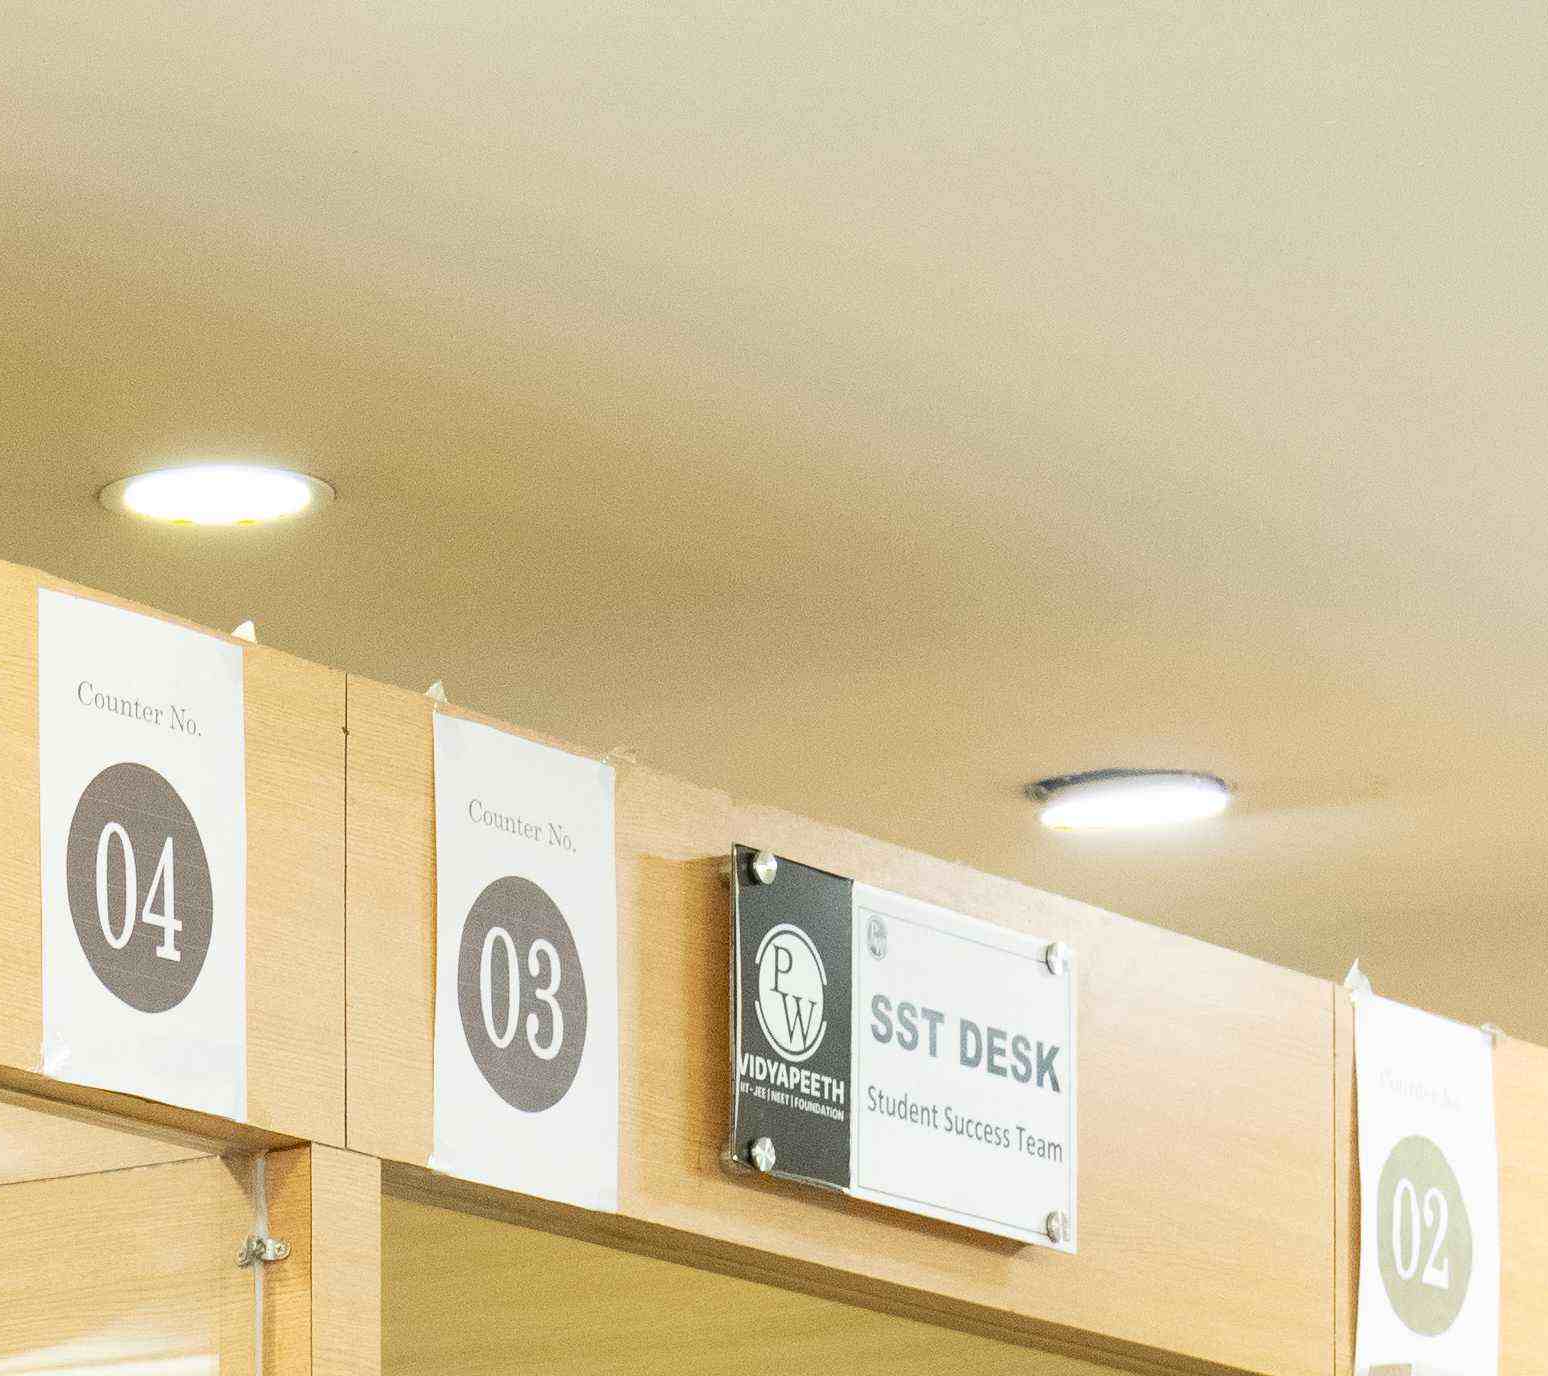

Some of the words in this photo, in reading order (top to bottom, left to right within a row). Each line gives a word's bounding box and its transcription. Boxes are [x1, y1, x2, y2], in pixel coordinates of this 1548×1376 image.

[77, 680, 164, 727] Counter
[169, 708, 203, 738] No.
[467, 798, 544, 841] Counter
[547, 822, 578, 854] No.
[95, 821, 183, 963] 04
[479, 926, 564, 1060] 03
[739, 1054, 845, 1104] VIDYAPEETH
[871, 993, 945, 1058] SST
[959, 1018, 1061, 1093] DESK
[772, 1091, 789, 1108] NEET
[793, 1097, 845, 1122] FOUNDATION
[867, 1085, 938, 1130] Student
[944, 1105, 1010, 1148] Success
[1015, 1126, 1063, 1163] Team
[1392, 1177, 1450, 1290] 02
